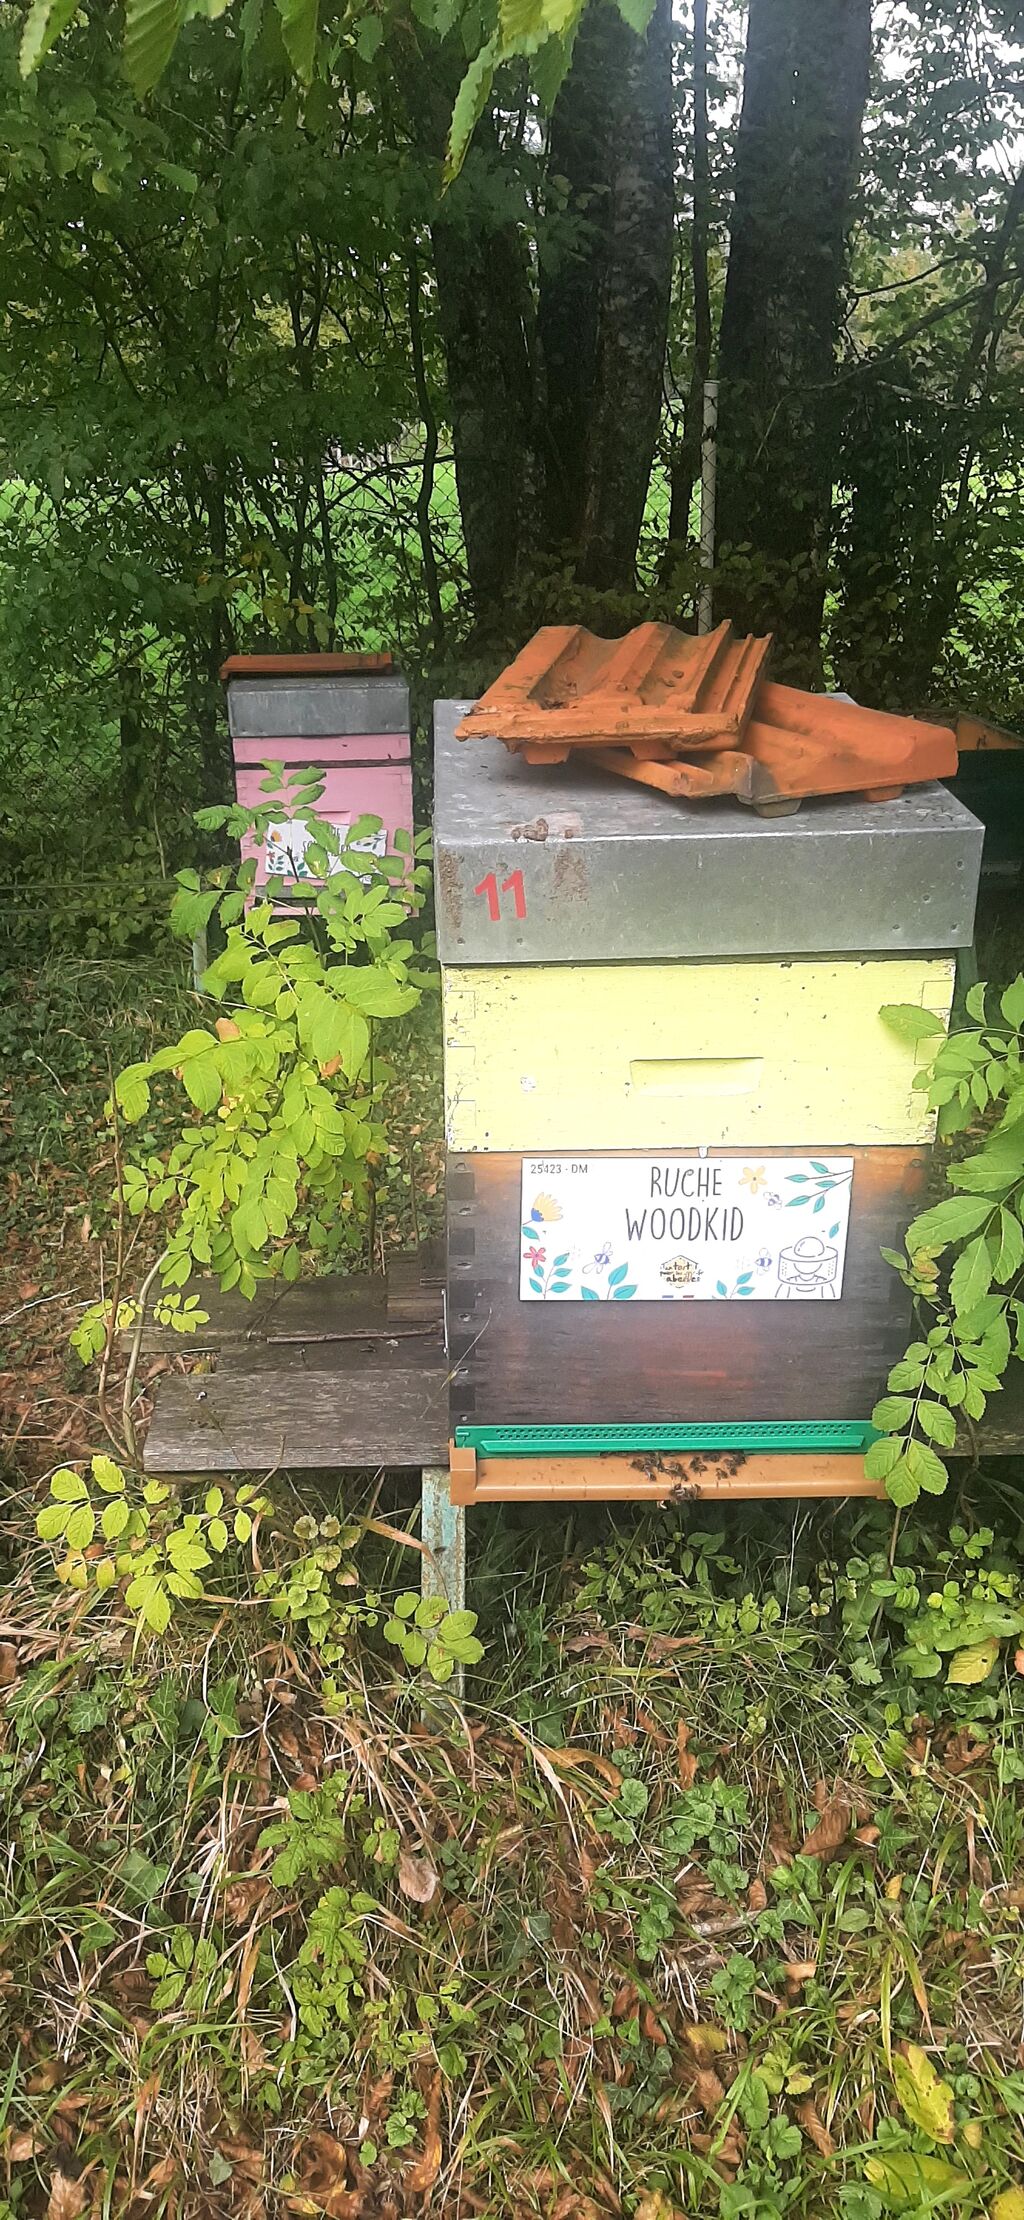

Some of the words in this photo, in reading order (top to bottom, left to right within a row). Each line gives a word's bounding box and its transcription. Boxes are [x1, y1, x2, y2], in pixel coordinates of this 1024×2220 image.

[474, 870, 527, 921] 11
[571, 1163, 588, 1174] DM
[650, 1166, 723, 1198] RUCHE
[625, 1206, 744, 1242] WOODKID
